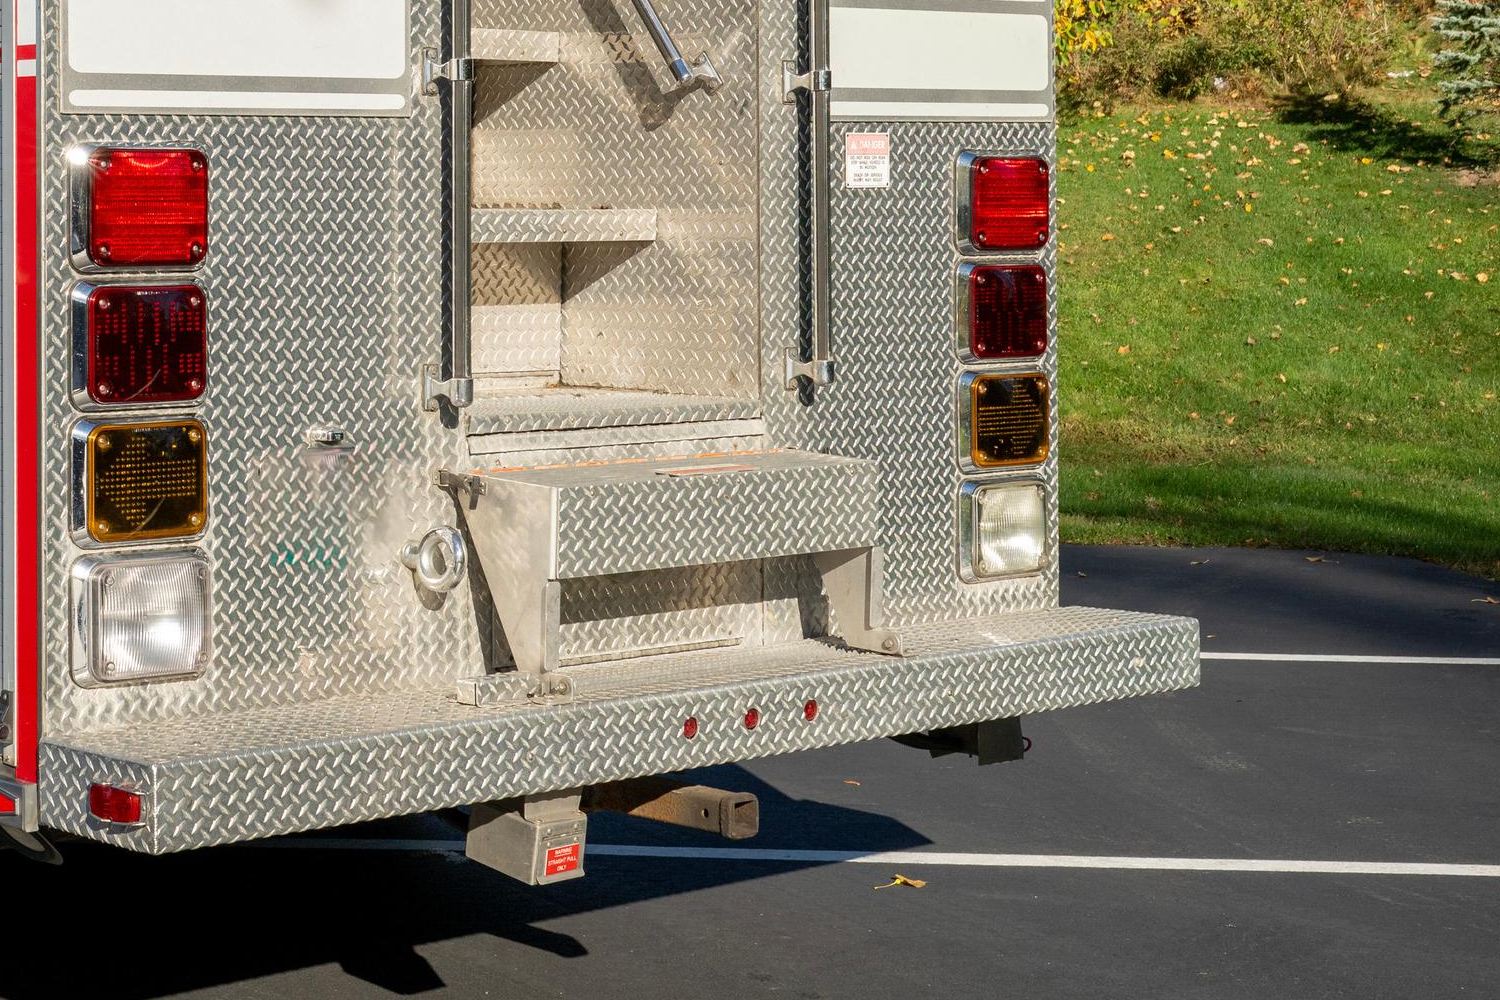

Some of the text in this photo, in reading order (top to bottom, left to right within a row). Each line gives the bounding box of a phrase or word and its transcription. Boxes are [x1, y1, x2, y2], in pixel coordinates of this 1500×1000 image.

[859, 140, 885, 149] DANGER
[554, 847, 572, 855] WARNING
[547, 856, 567, 866] STRAIGHT
[556, 864, 567, 872] ONLY
